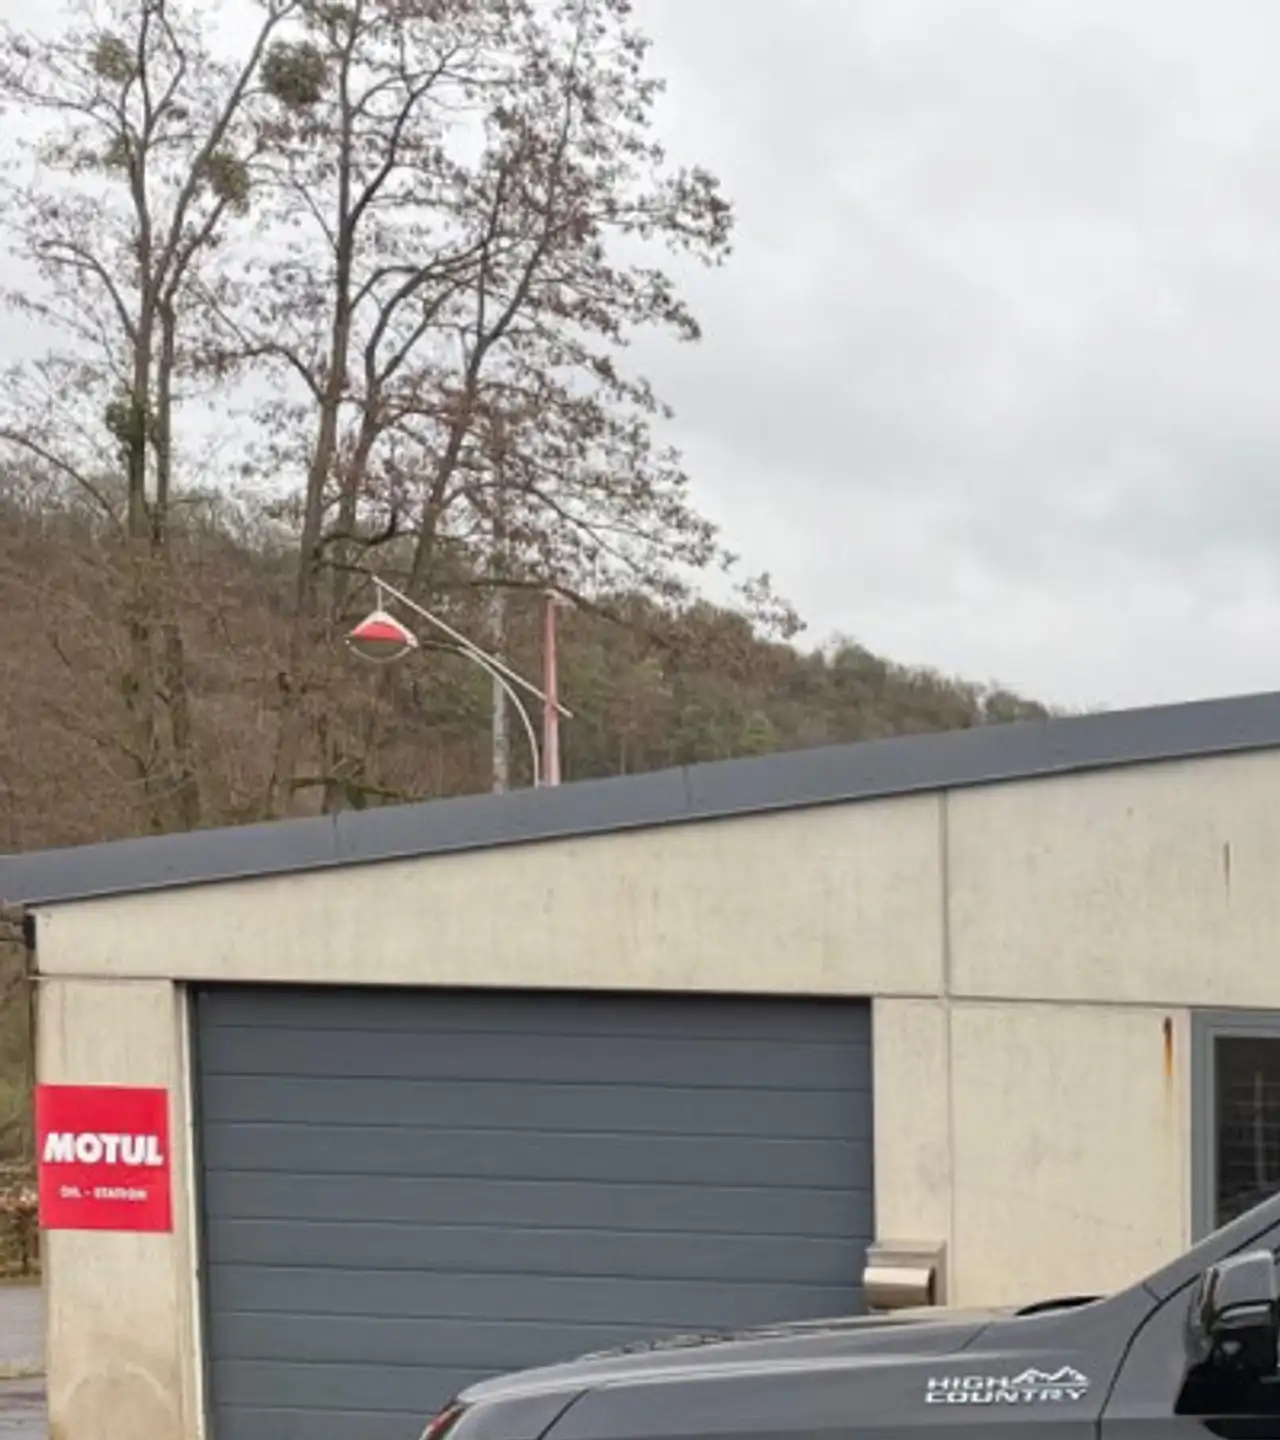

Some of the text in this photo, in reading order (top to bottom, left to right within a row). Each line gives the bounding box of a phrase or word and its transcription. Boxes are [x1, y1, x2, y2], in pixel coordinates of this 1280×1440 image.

[43, 1132, 163, 1166] MOTUL
[927, 1376, 1009, 1390] HIGH
[924, 1389, 1087, 1404] COUNTRY
